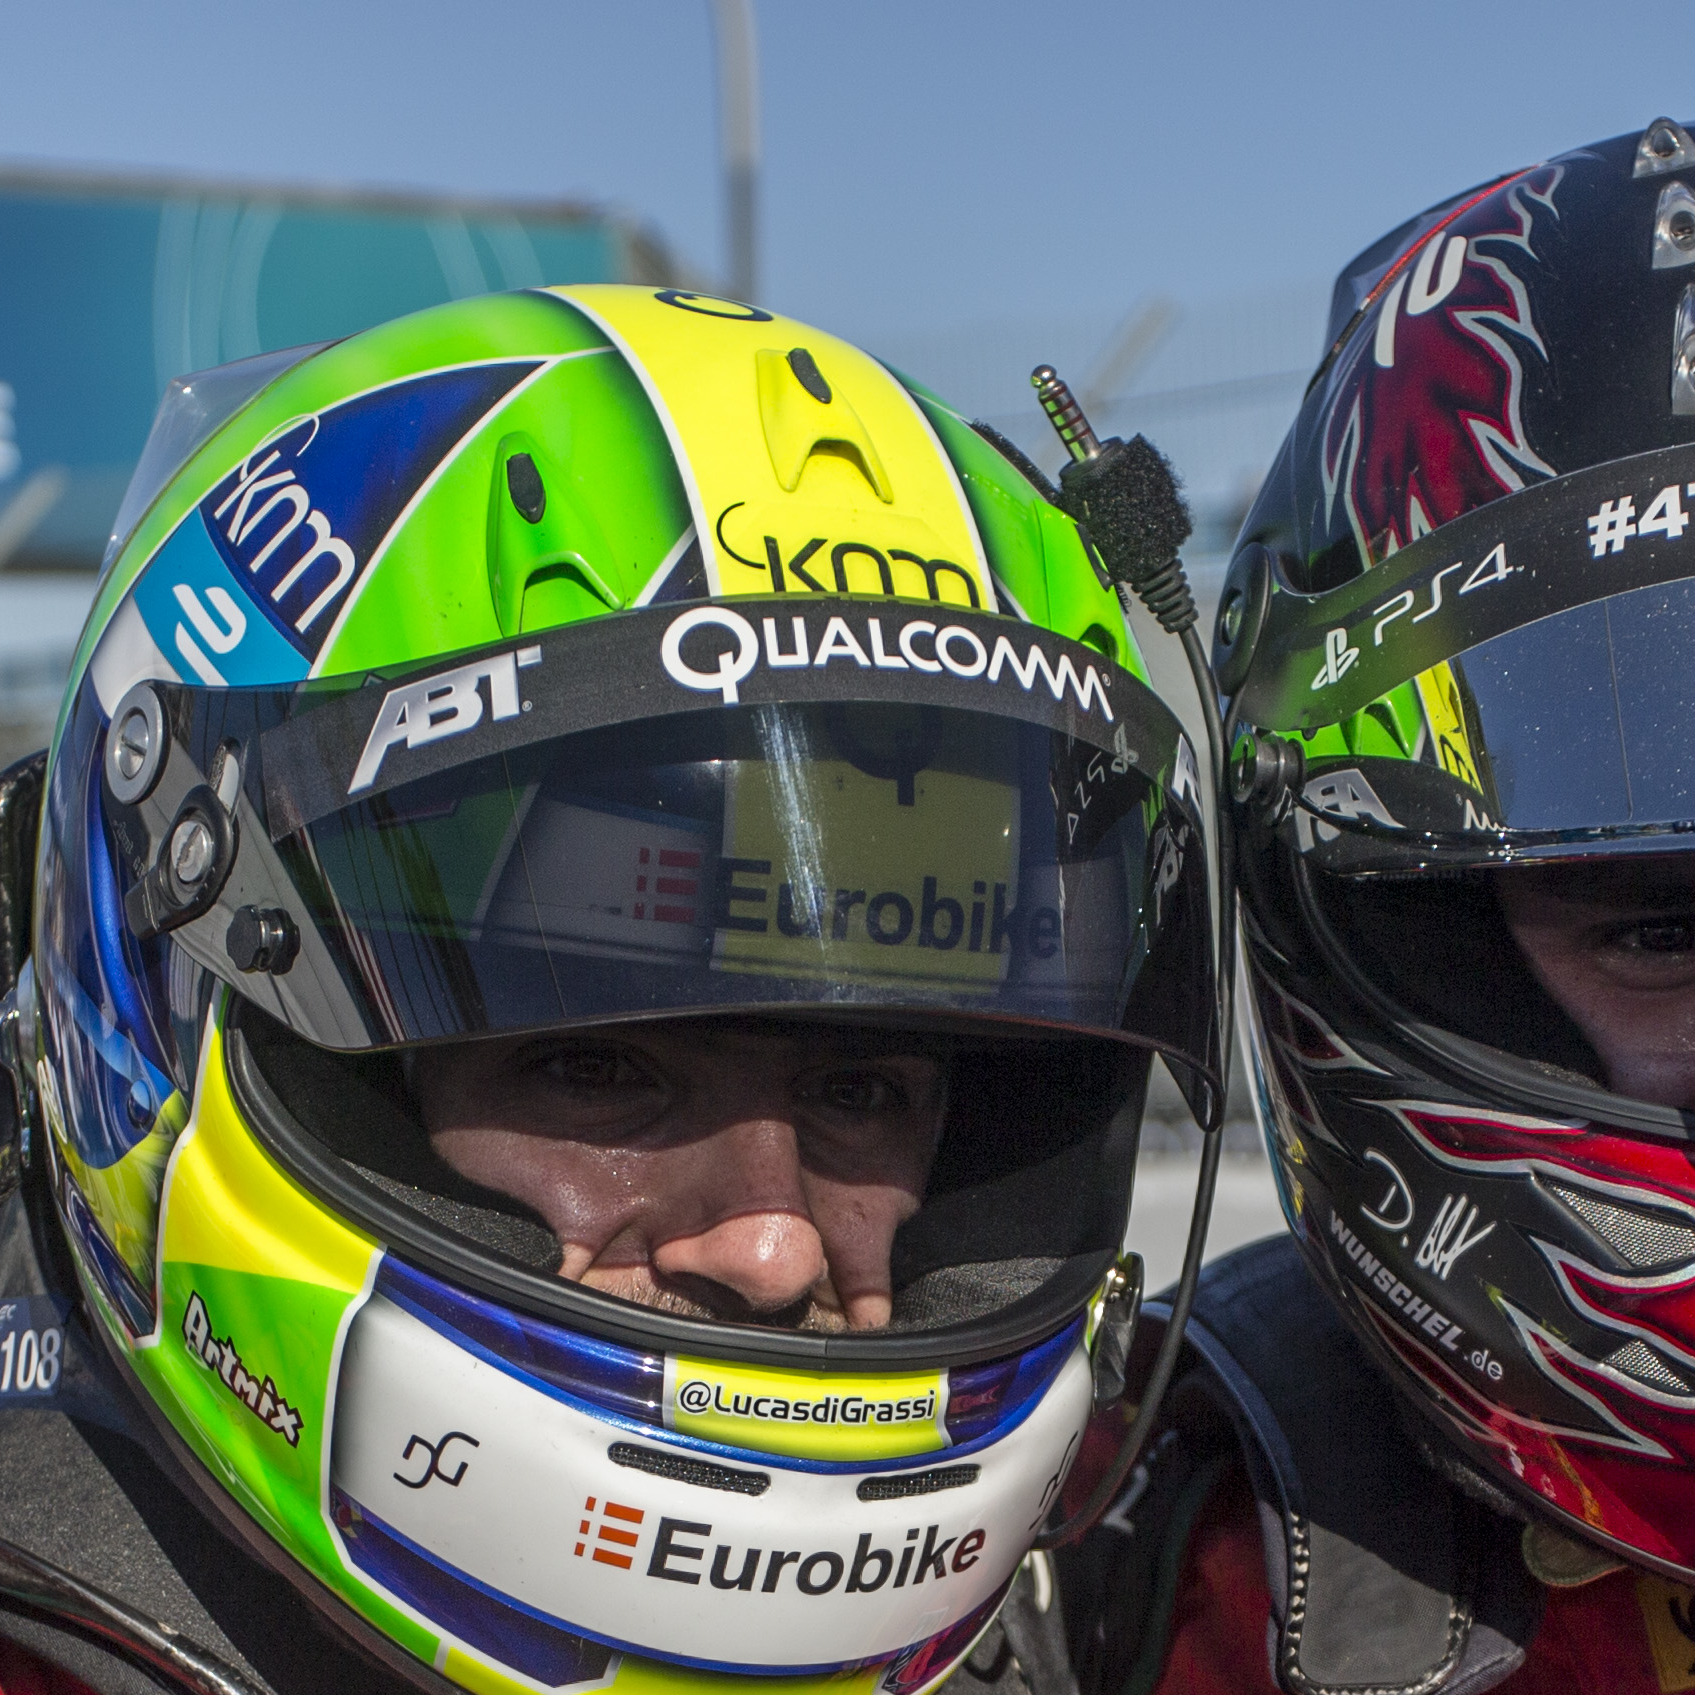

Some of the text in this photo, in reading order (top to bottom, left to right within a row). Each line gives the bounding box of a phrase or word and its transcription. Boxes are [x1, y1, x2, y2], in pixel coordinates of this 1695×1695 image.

[1372, 542, 1510, 647] PS4
[660, 604, 1115, 723] QUALCOMM
[347, 644, 543, 795] ABT
[0, 1328, 62, 1393] 108
[182, 1289, 304, 1447] Artmix
[678, 1380, 936, 1424] @LucasdiGrassi
[646, 1515, 987, 1596] Eurobike
